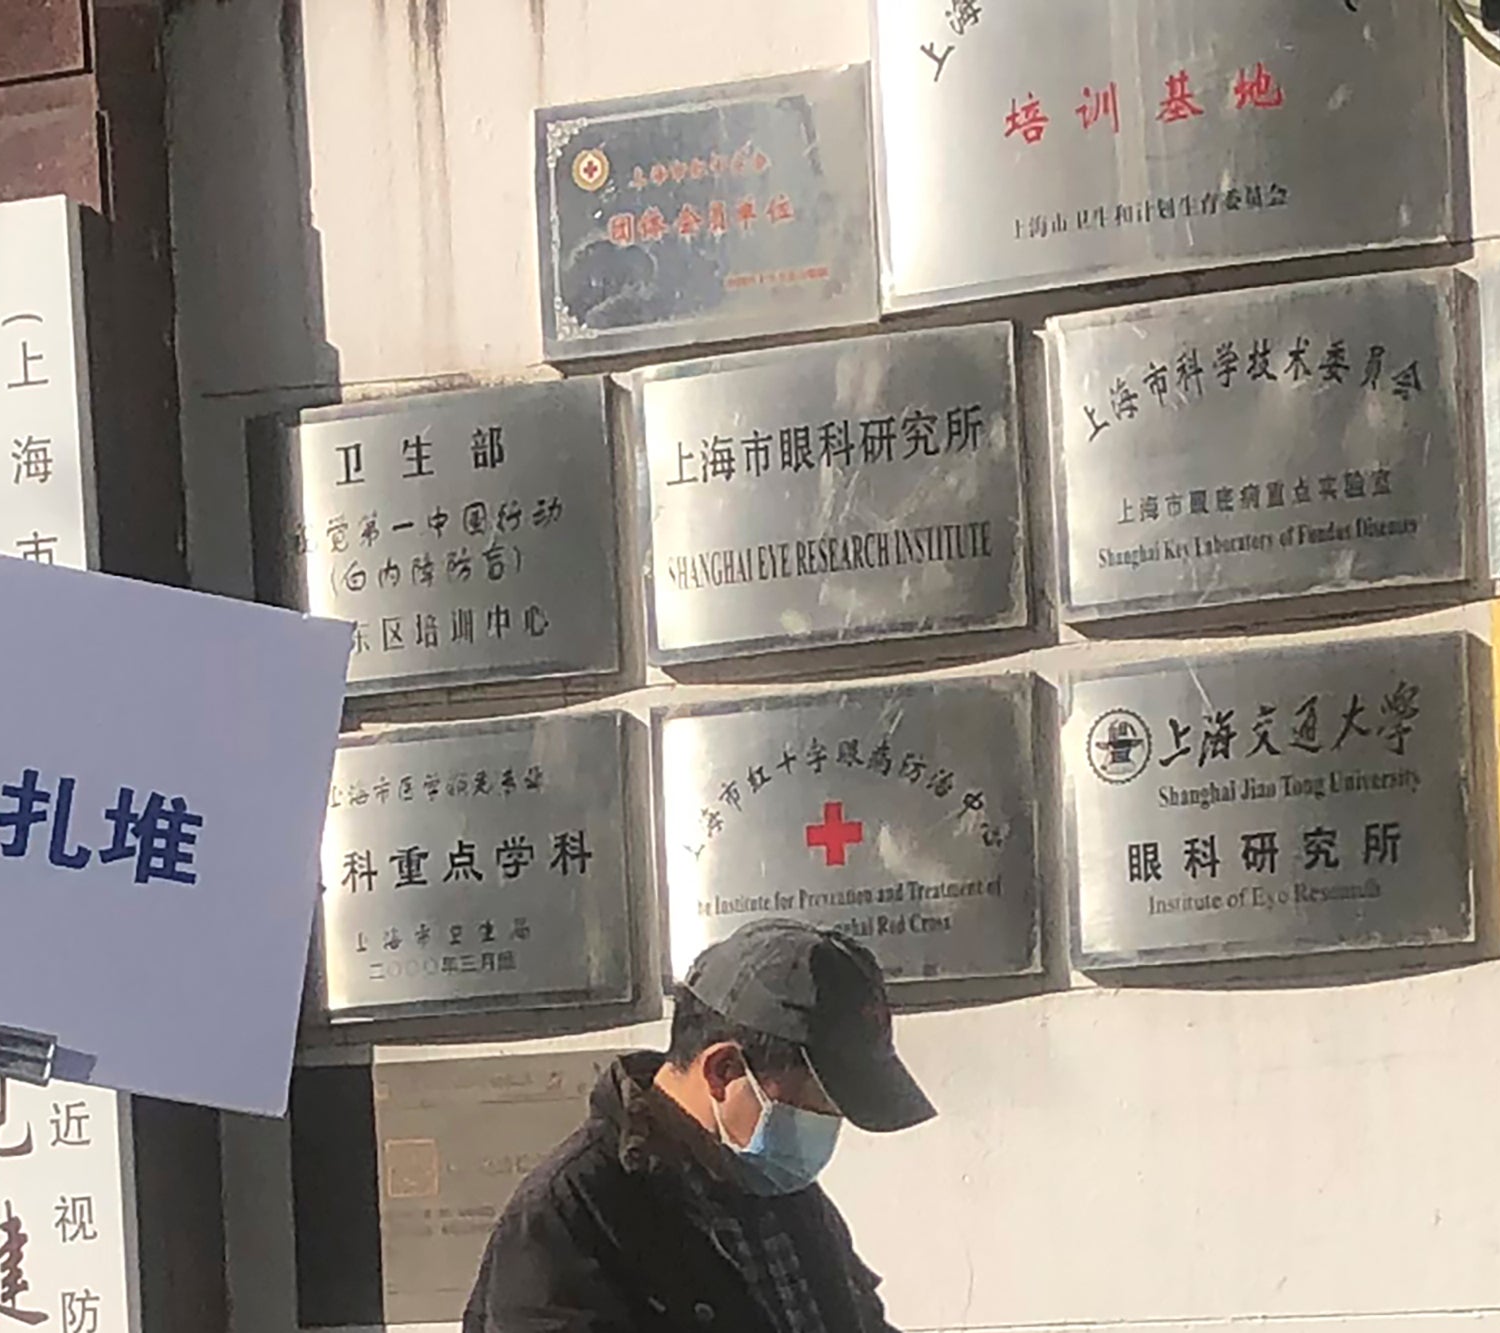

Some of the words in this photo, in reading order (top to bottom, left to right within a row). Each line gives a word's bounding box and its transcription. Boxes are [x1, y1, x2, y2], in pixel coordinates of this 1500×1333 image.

[1004, 61, 1284, 145] 培训基地
[1013, 182, 1290, 241] 上海市卫生和计划生育委员会
[1081, 336, 1424, 442] 上海市科学技术委员会
[335, 426, 506, 486] 卫生部
[665, 404, 985, 487] 上海市眼科研究所
[667, 548, 754, 591] SHANGHAI
[757, 541, 792, 582] EYE
[796, 531, 890, 577] RESEARCH
[894, 519, 993, 567] INSTITUTE
[1097, 539, 1160, 570] Shanghai
[1279, 524, 1295, 548] of
[1158, 779, 1237, 810] Shanghai
[1240, 777, 1277, 803] Jiao
[1280, 772, 1327, 800] Tong
[1329, 768, 1421, 796] University
[341, 828, 593, 894] 科重点学科
[1128, 821, 1402, 883] 眼科研究所
[1148, 890, 1222, 916] Institute
[1226, 888, 1248, 909] of
